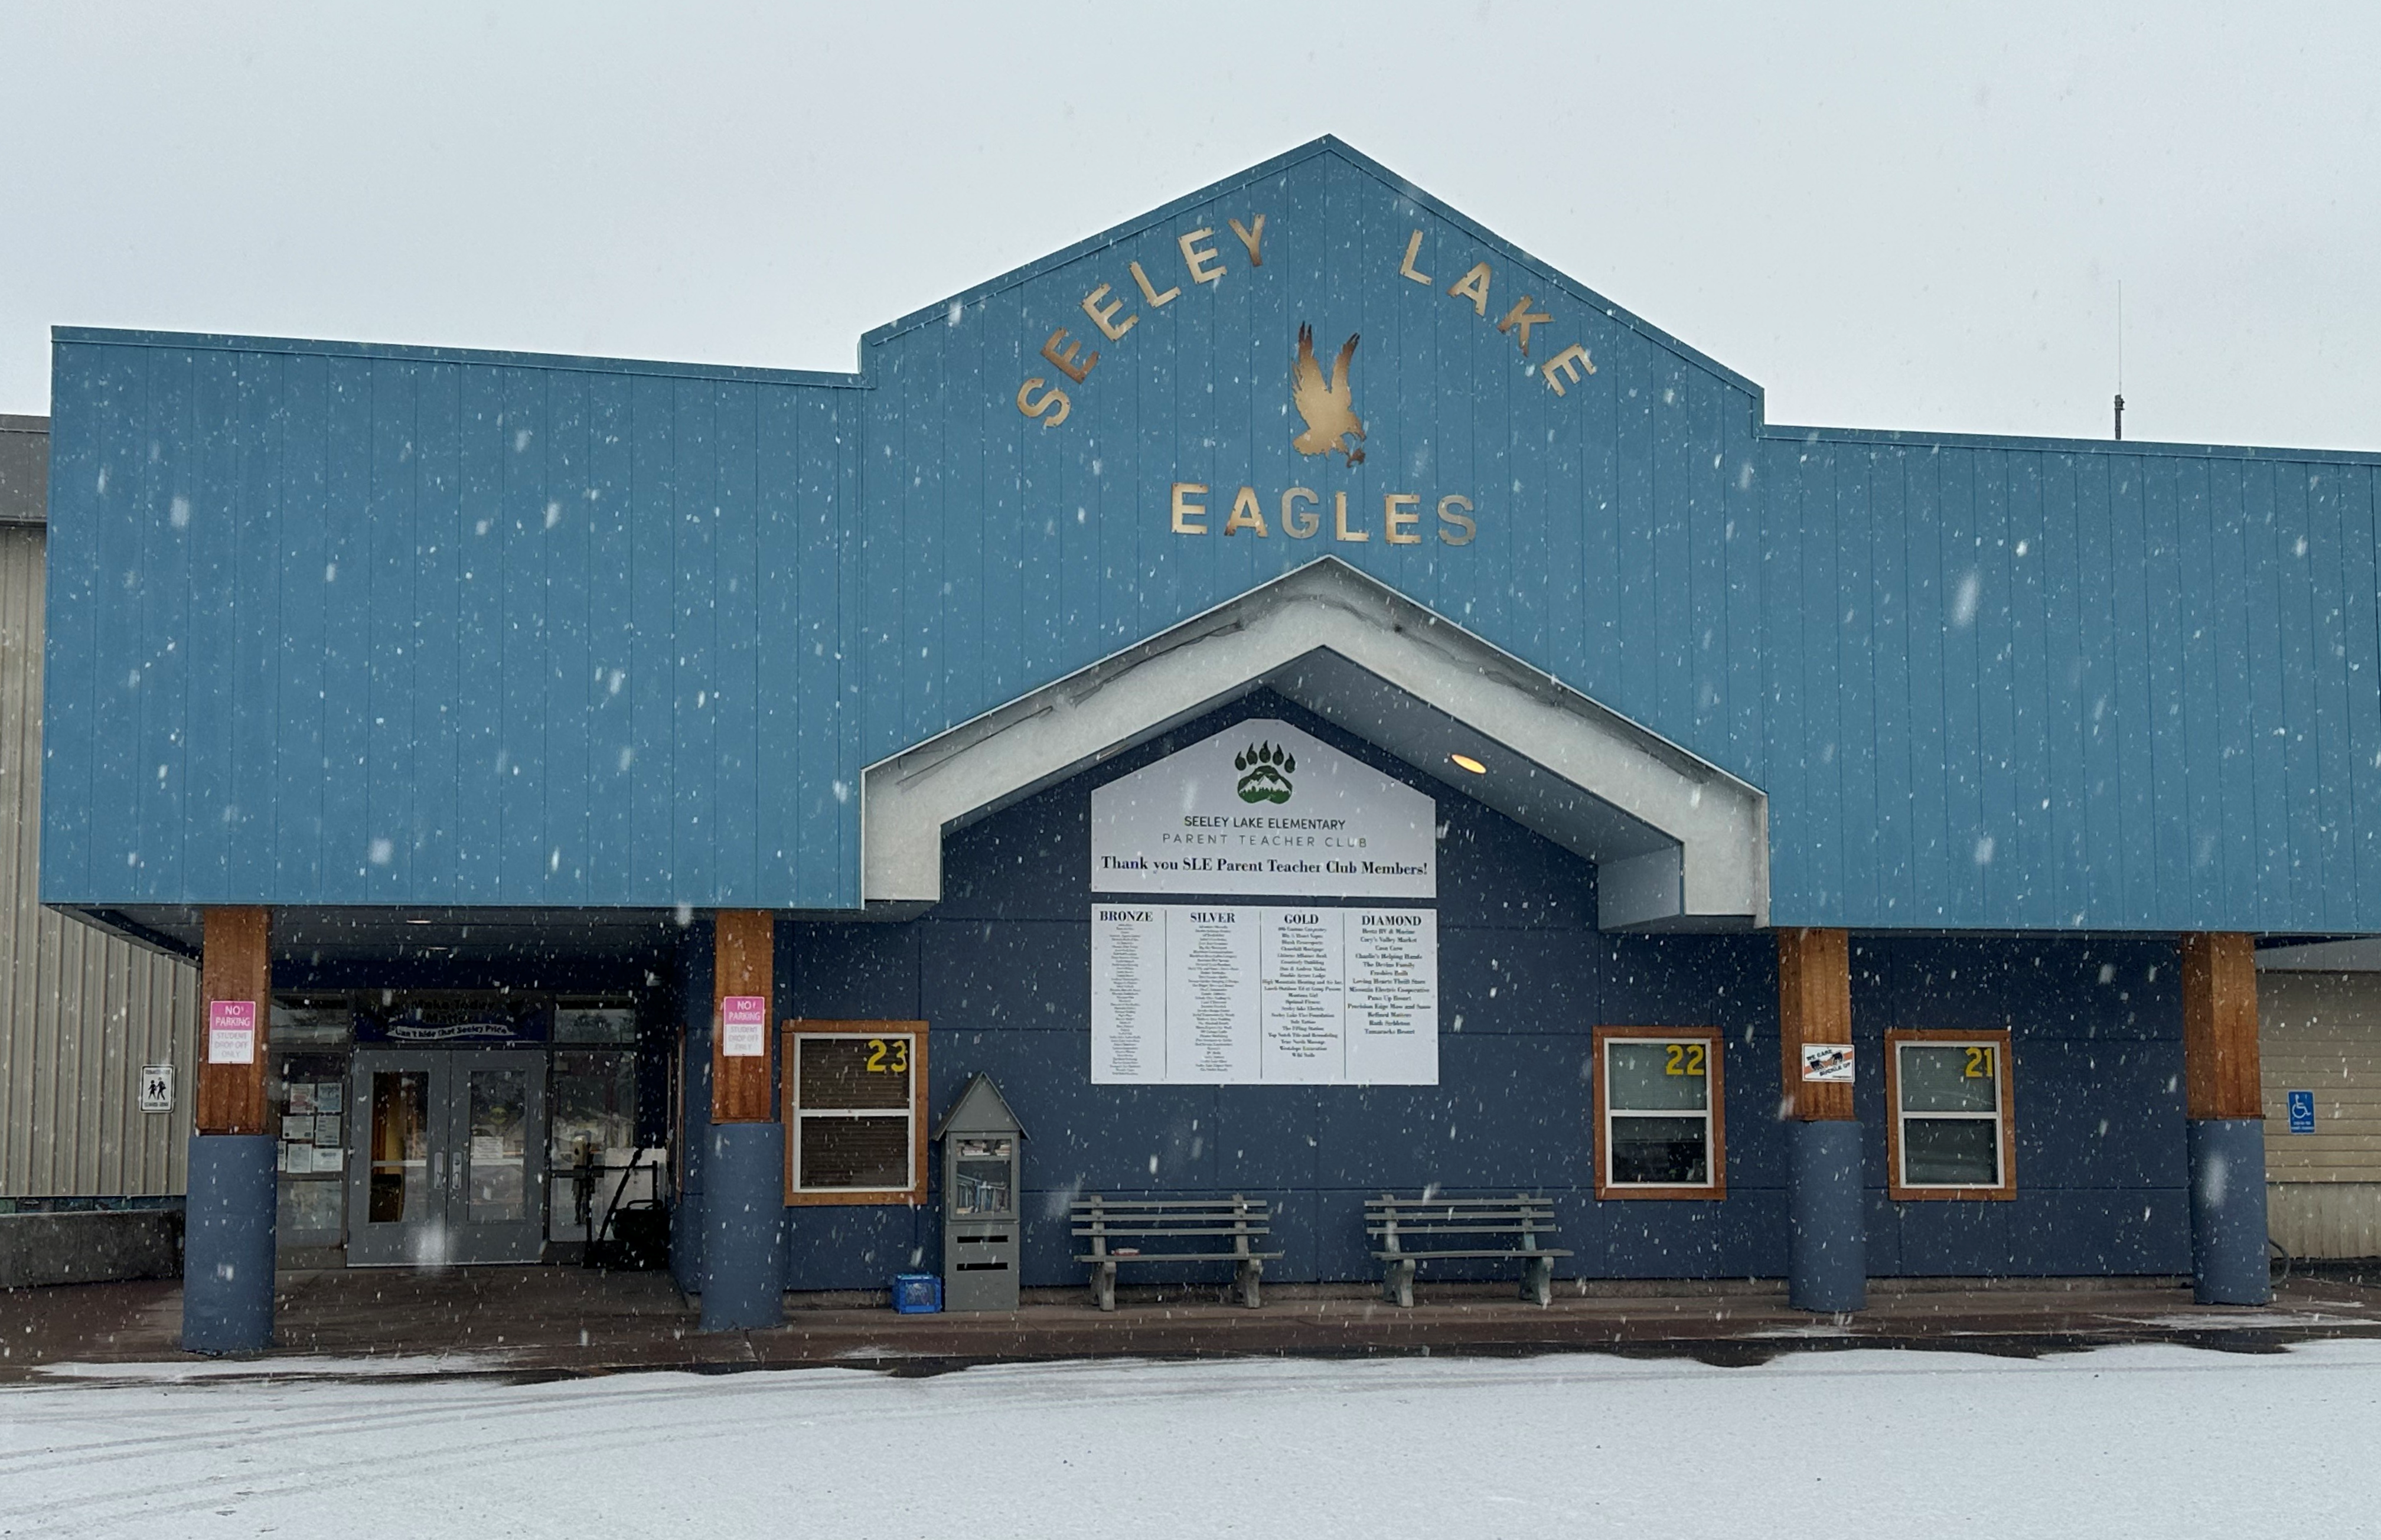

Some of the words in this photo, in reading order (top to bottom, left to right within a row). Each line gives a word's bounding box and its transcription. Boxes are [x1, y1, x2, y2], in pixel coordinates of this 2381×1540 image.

[1016, 214, 1265, 428] SEELEY
[1400, 229, 1597, 397] LAKE
[1172, 482, 1476, 546] EAGLES
[1185, 815, 1229, 827] SEELEY
[1234, 817, 1263, 828] LAKE
[1268, 818, 1345, 830] ELEMENTARY
[1163, 833, 1227, 844] PARENT
[1239, 835, 1315, 846] TEACHER
[1325, 837, 1366, 847] CLUB
[1101, 856, 1148, 869] Thank
[1153, 862, 1178, 874] you
[1183, 857, 1212, 871] SLE
[1216, 858, 1263, 872] Parent
[1267, 859, 1322, 873] Teacher
[1326, 860, 1356, 874] Club
[1361, 861, 1427, 875] Members!
[1100, 911, 1153, 922] BRONZE
[1190, 912, 1235, 923] SILVER
[1284, 913, 1319, 924] GOLD
[1362, 915, 1421, 926] DIAMOND
[225, 1006, 241, 1015] NO
[737, 1001, 752, 1010] NO
[216, 1017, 250, 1026] PARKING
[729, 1012, 761, 1021] PARKING
[867, 1039, 908, 1072] 23
[1665, 1045, 1705, 1076] 22
[1965, 1047, 1993, 1078] 21
